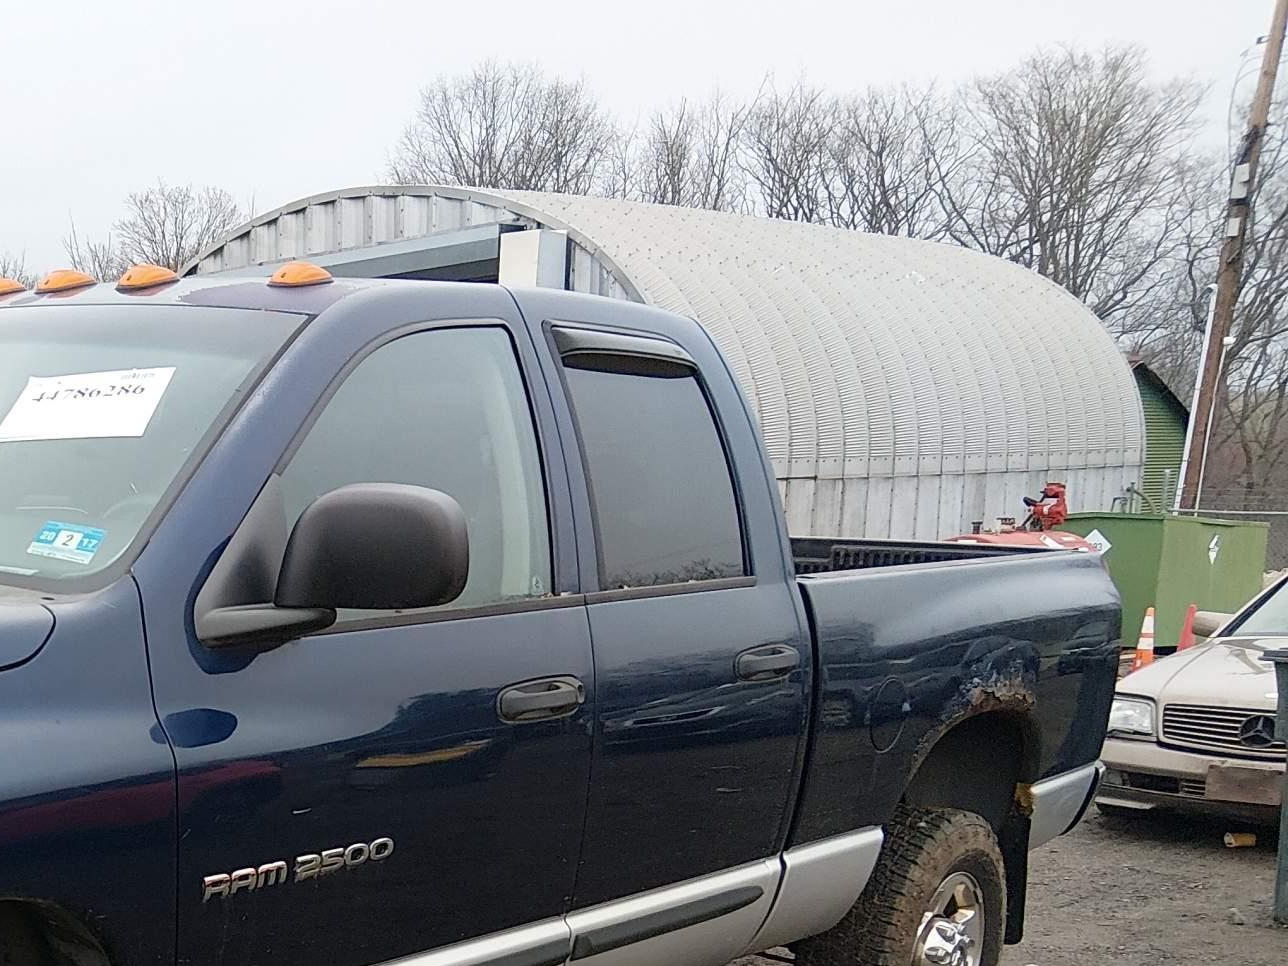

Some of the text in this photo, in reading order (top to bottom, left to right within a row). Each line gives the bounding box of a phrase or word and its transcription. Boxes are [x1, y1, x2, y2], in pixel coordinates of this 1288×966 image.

[61, 533, 75, 546] 2
[201, 836, 396, 904] RAM 2500
